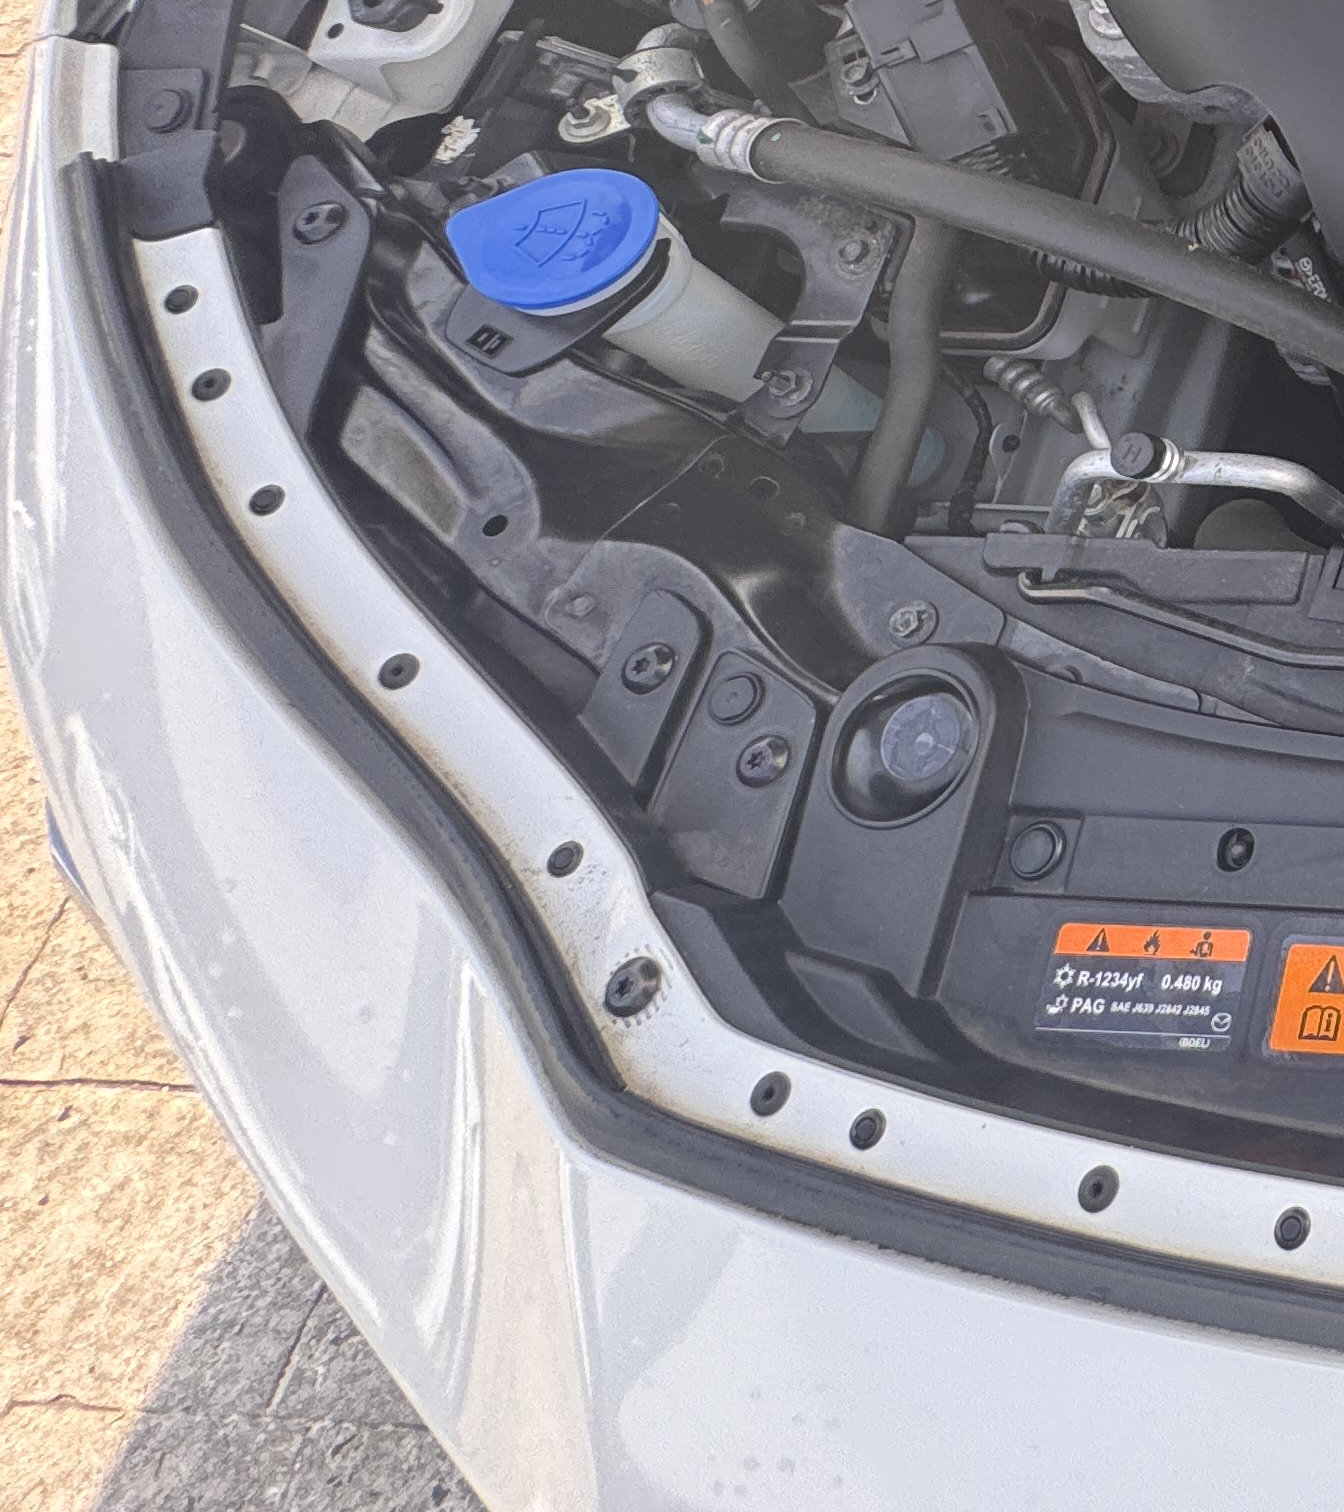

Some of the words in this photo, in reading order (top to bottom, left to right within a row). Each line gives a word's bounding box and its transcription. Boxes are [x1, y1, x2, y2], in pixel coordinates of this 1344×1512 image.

[1076, 969, 1144, 992] R-1234yf
[1160, 973, 1200, 991] 0.480
[1202, 975, 1223, 996] kg
[1070, 996, 1106, 1014] PAG
[1110, 1000, 1131, 1013] SAE
[1131, 1002, 1154, 1015] J639
